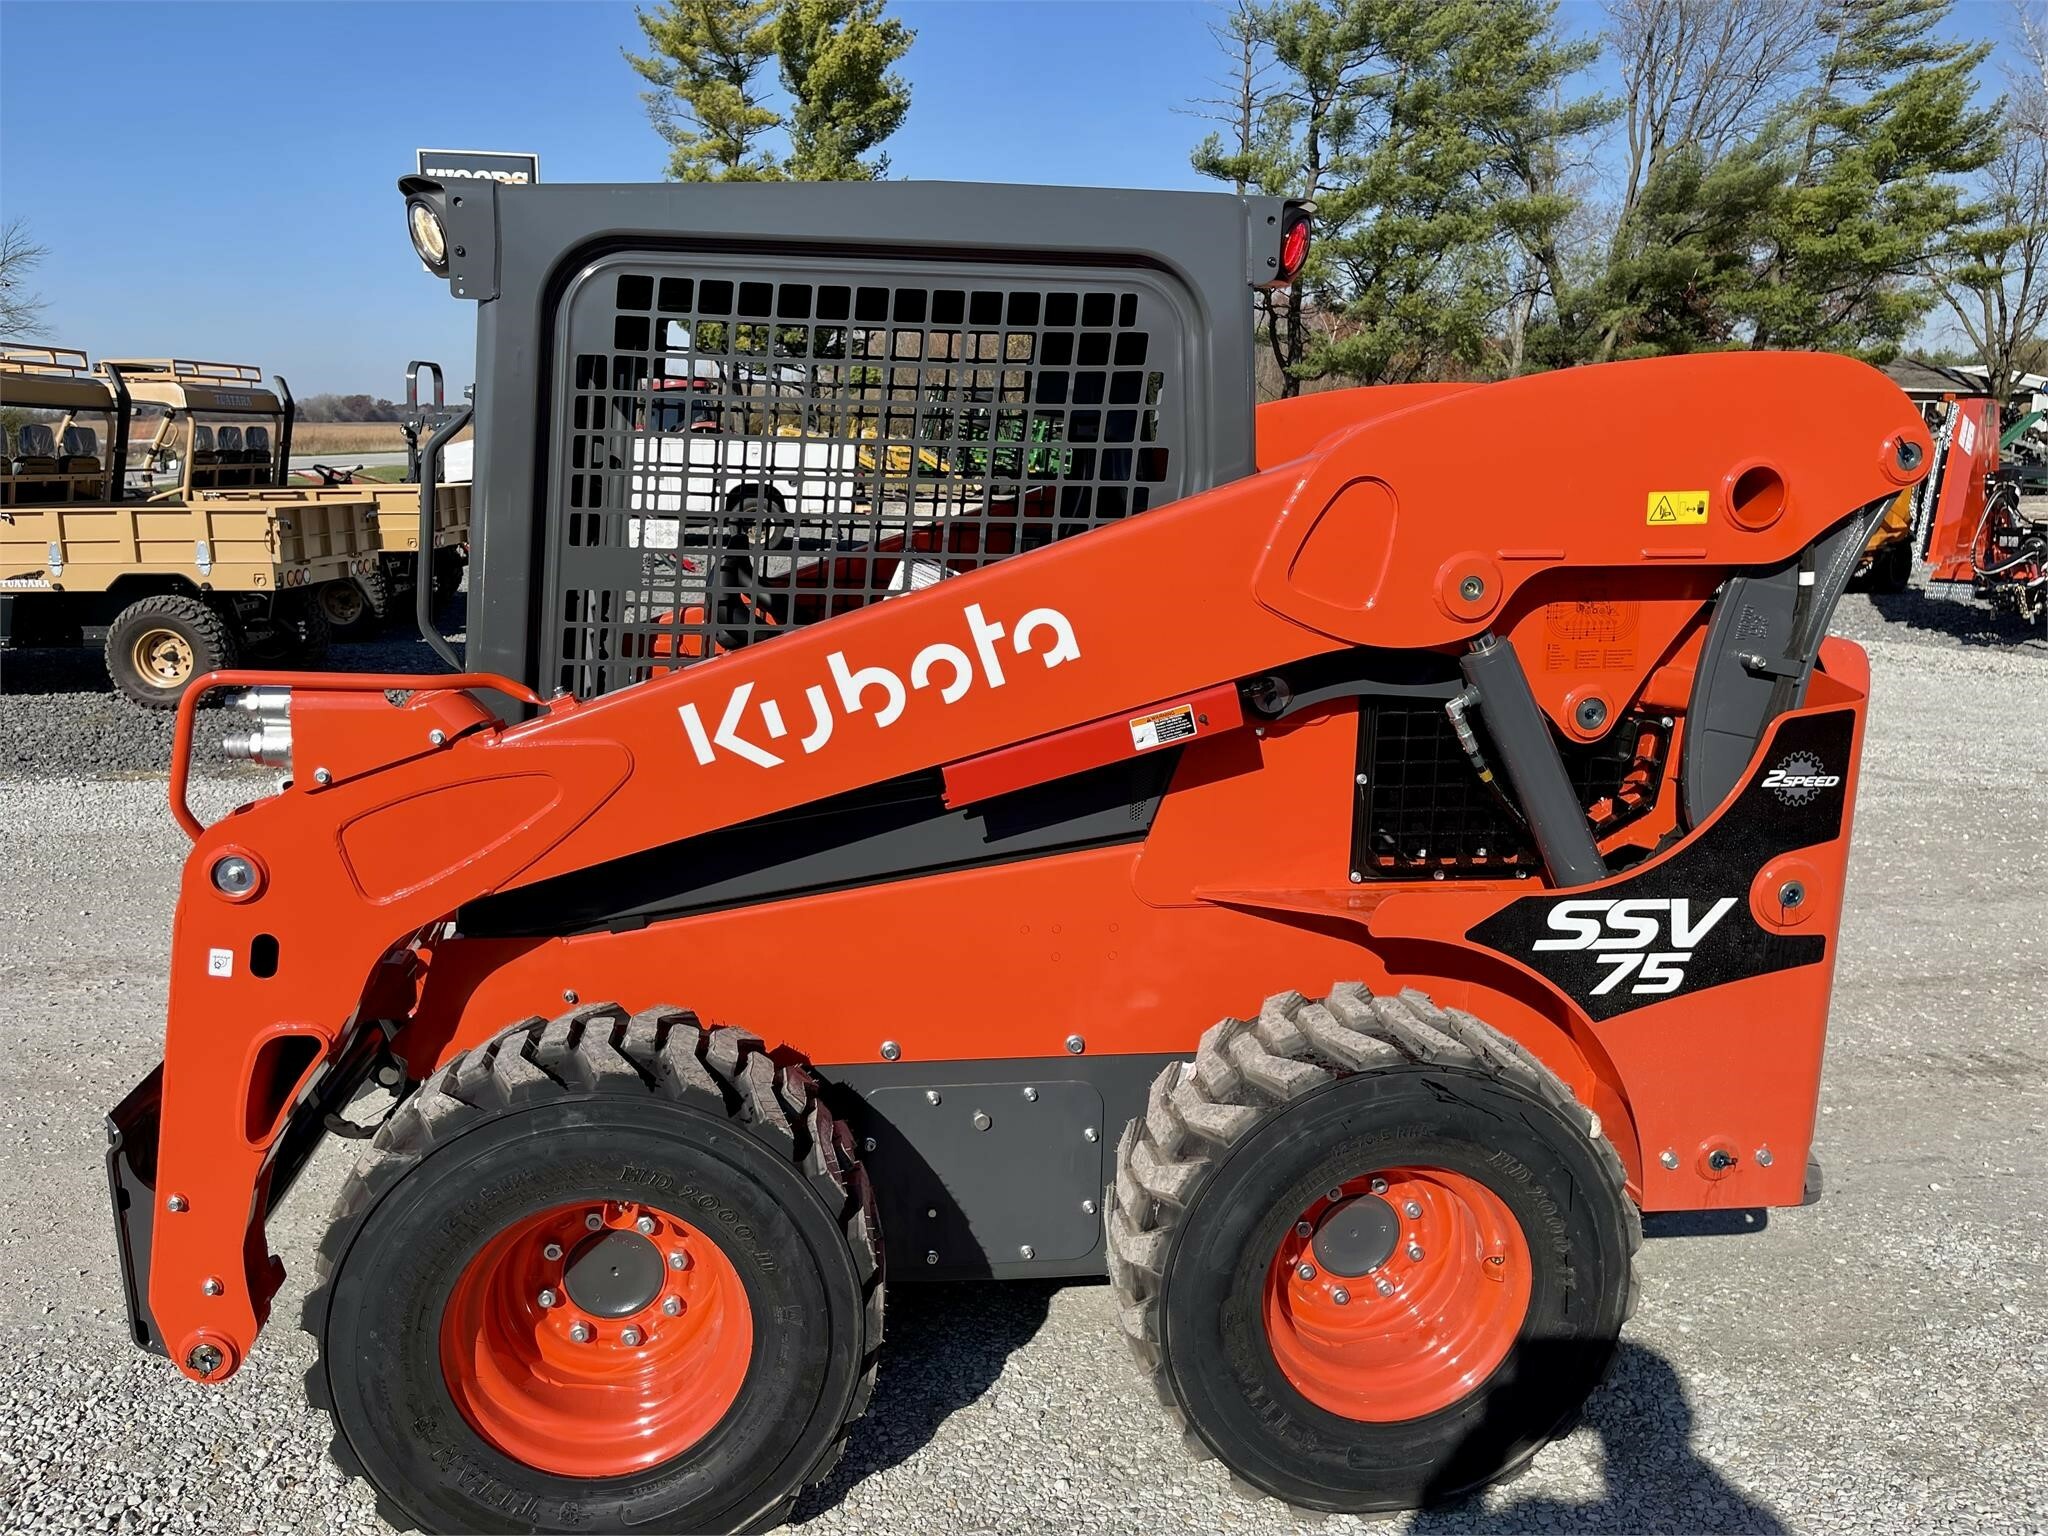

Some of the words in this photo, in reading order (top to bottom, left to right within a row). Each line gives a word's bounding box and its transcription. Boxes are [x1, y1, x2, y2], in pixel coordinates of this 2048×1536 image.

[678, 603, 1081, 769] Kubota
[1532, 897, 1739, 951] SSV
[1589, 952, 1692, 995] 75
